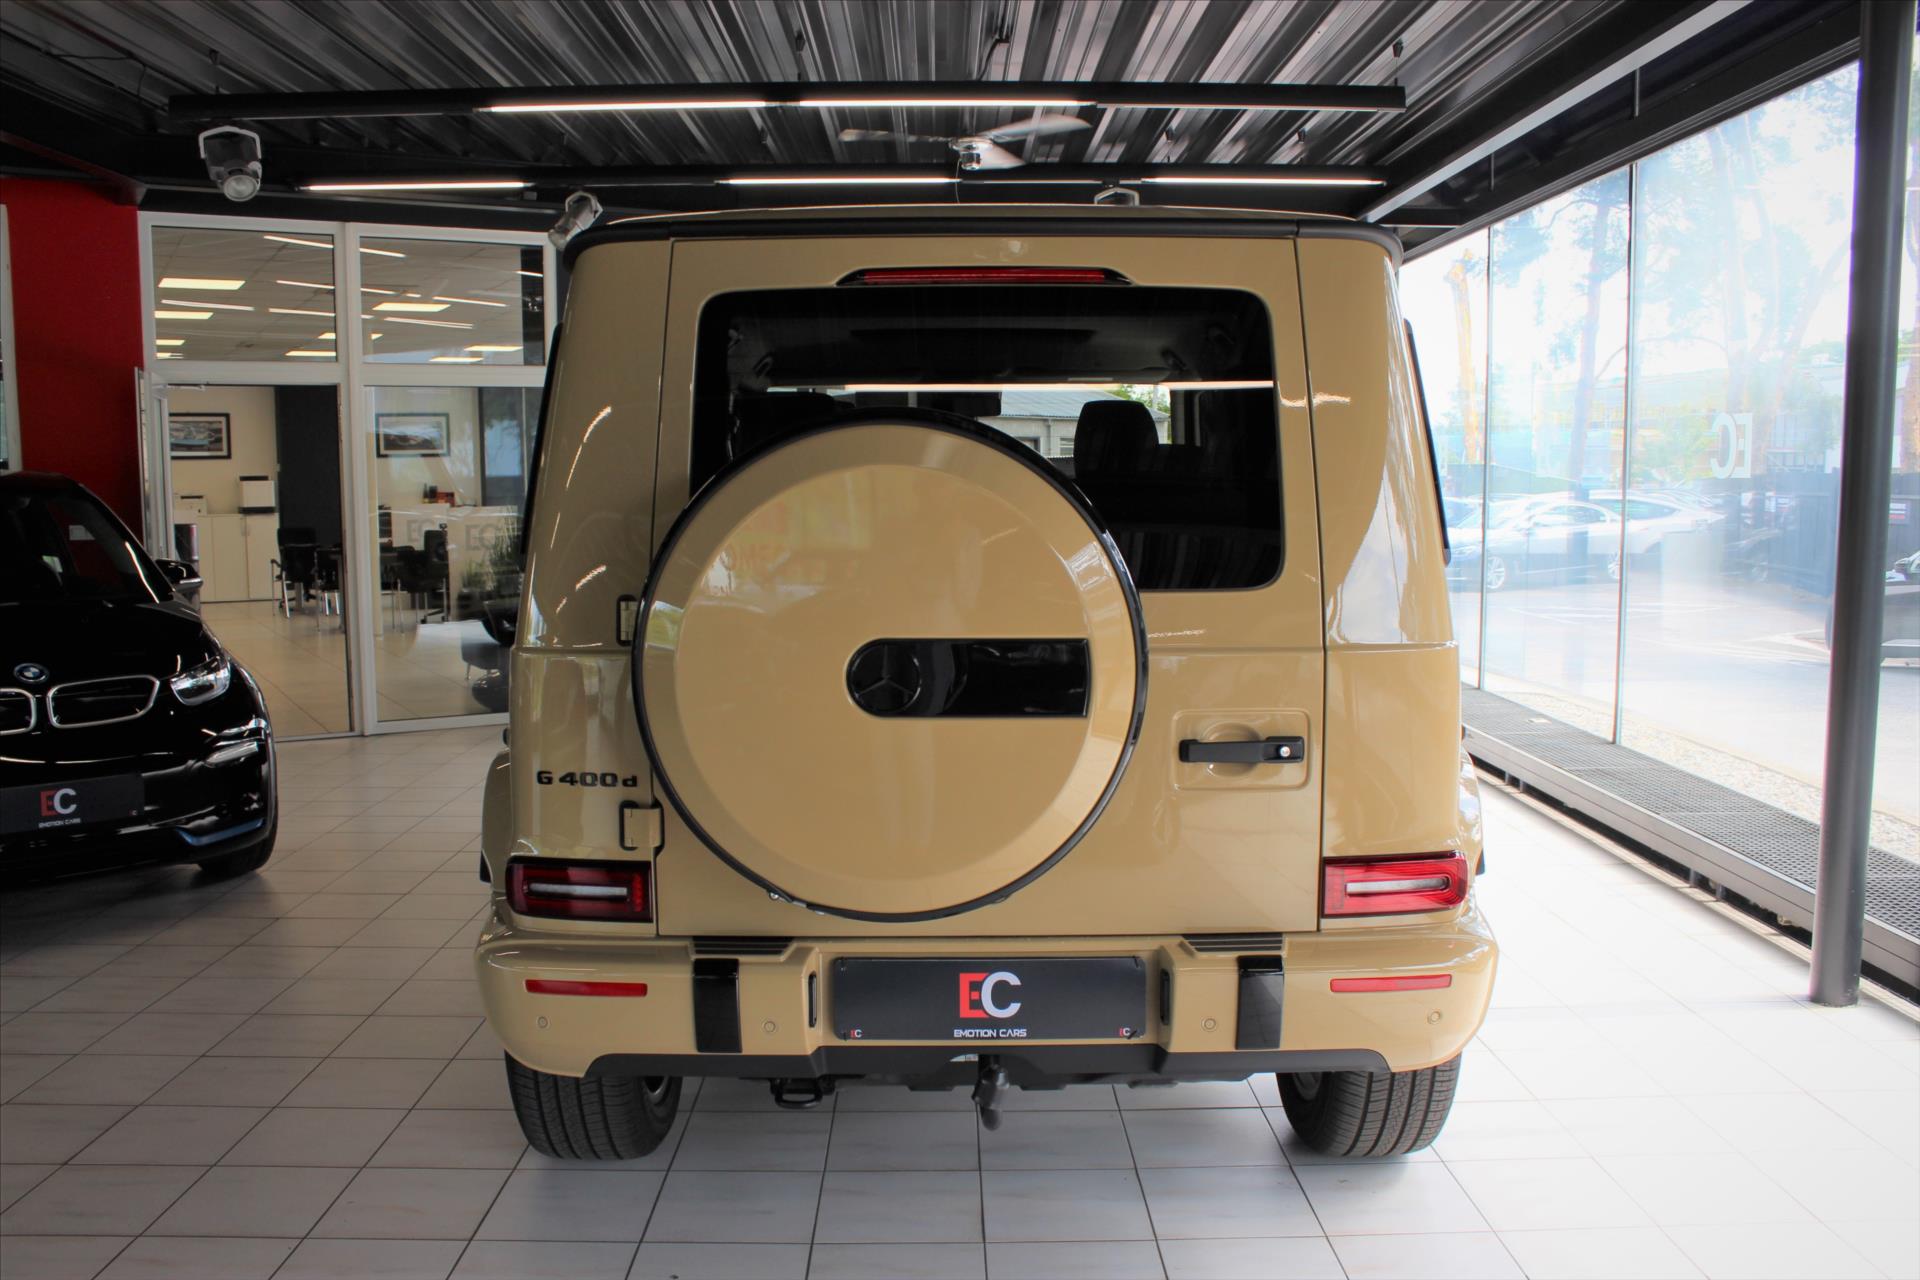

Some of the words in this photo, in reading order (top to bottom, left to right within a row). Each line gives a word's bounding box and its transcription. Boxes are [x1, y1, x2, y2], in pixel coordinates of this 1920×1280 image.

[41, 788, 77, 816] EC
[959, 971, 1022, 1019] EC
[953, 1028, 997, 1038] EMOTION
[999, 1028, 1027, 1037] CARS
